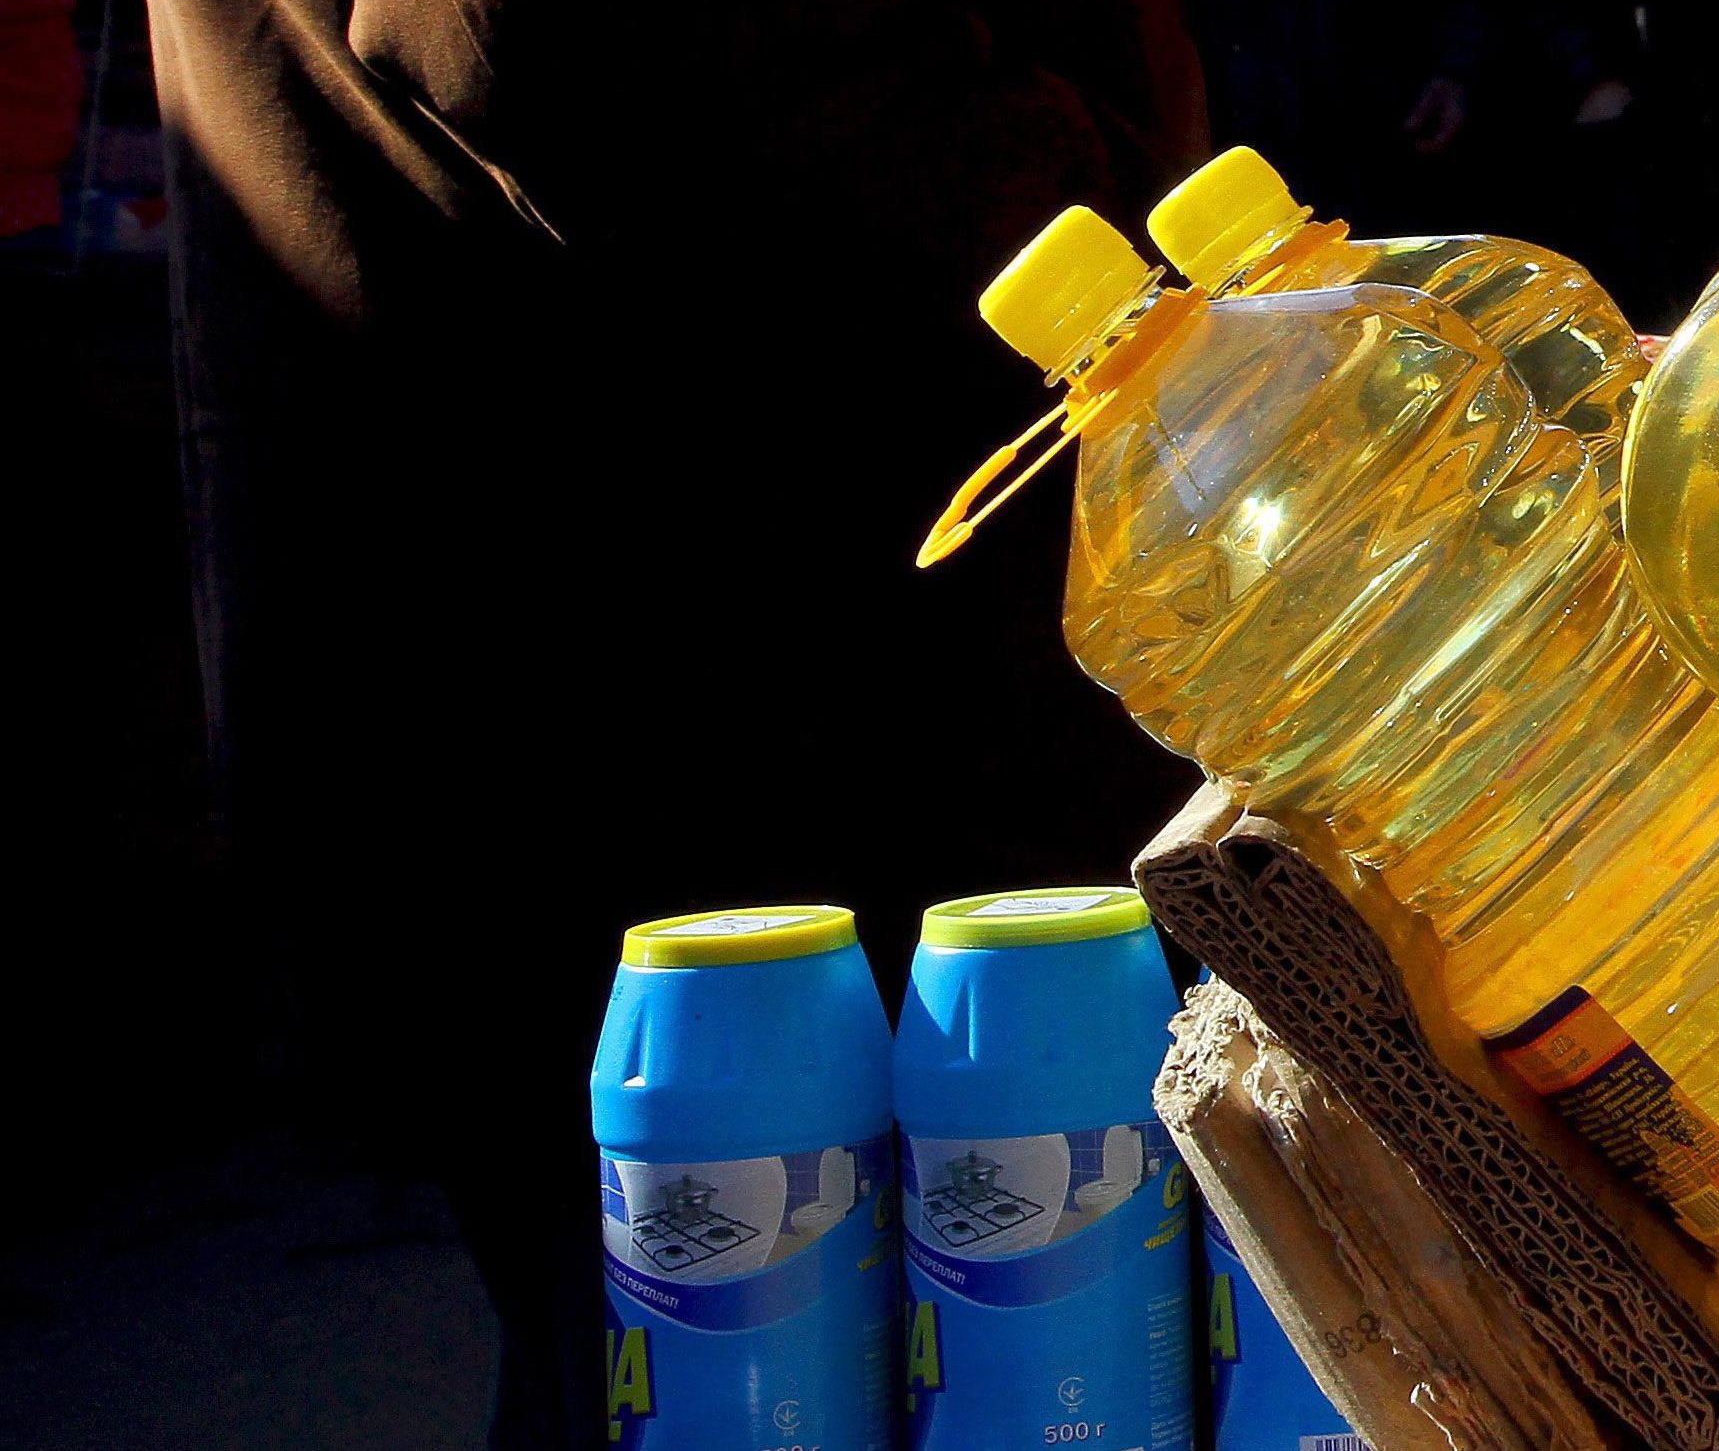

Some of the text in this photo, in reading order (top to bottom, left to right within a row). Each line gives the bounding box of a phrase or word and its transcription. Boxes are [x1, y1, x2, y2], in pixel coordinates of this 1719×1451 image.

[626, 1275, 680, 1309] ПЕРЕПЛАТ!
[1044, 1422, 1106, 1445] 500 г
